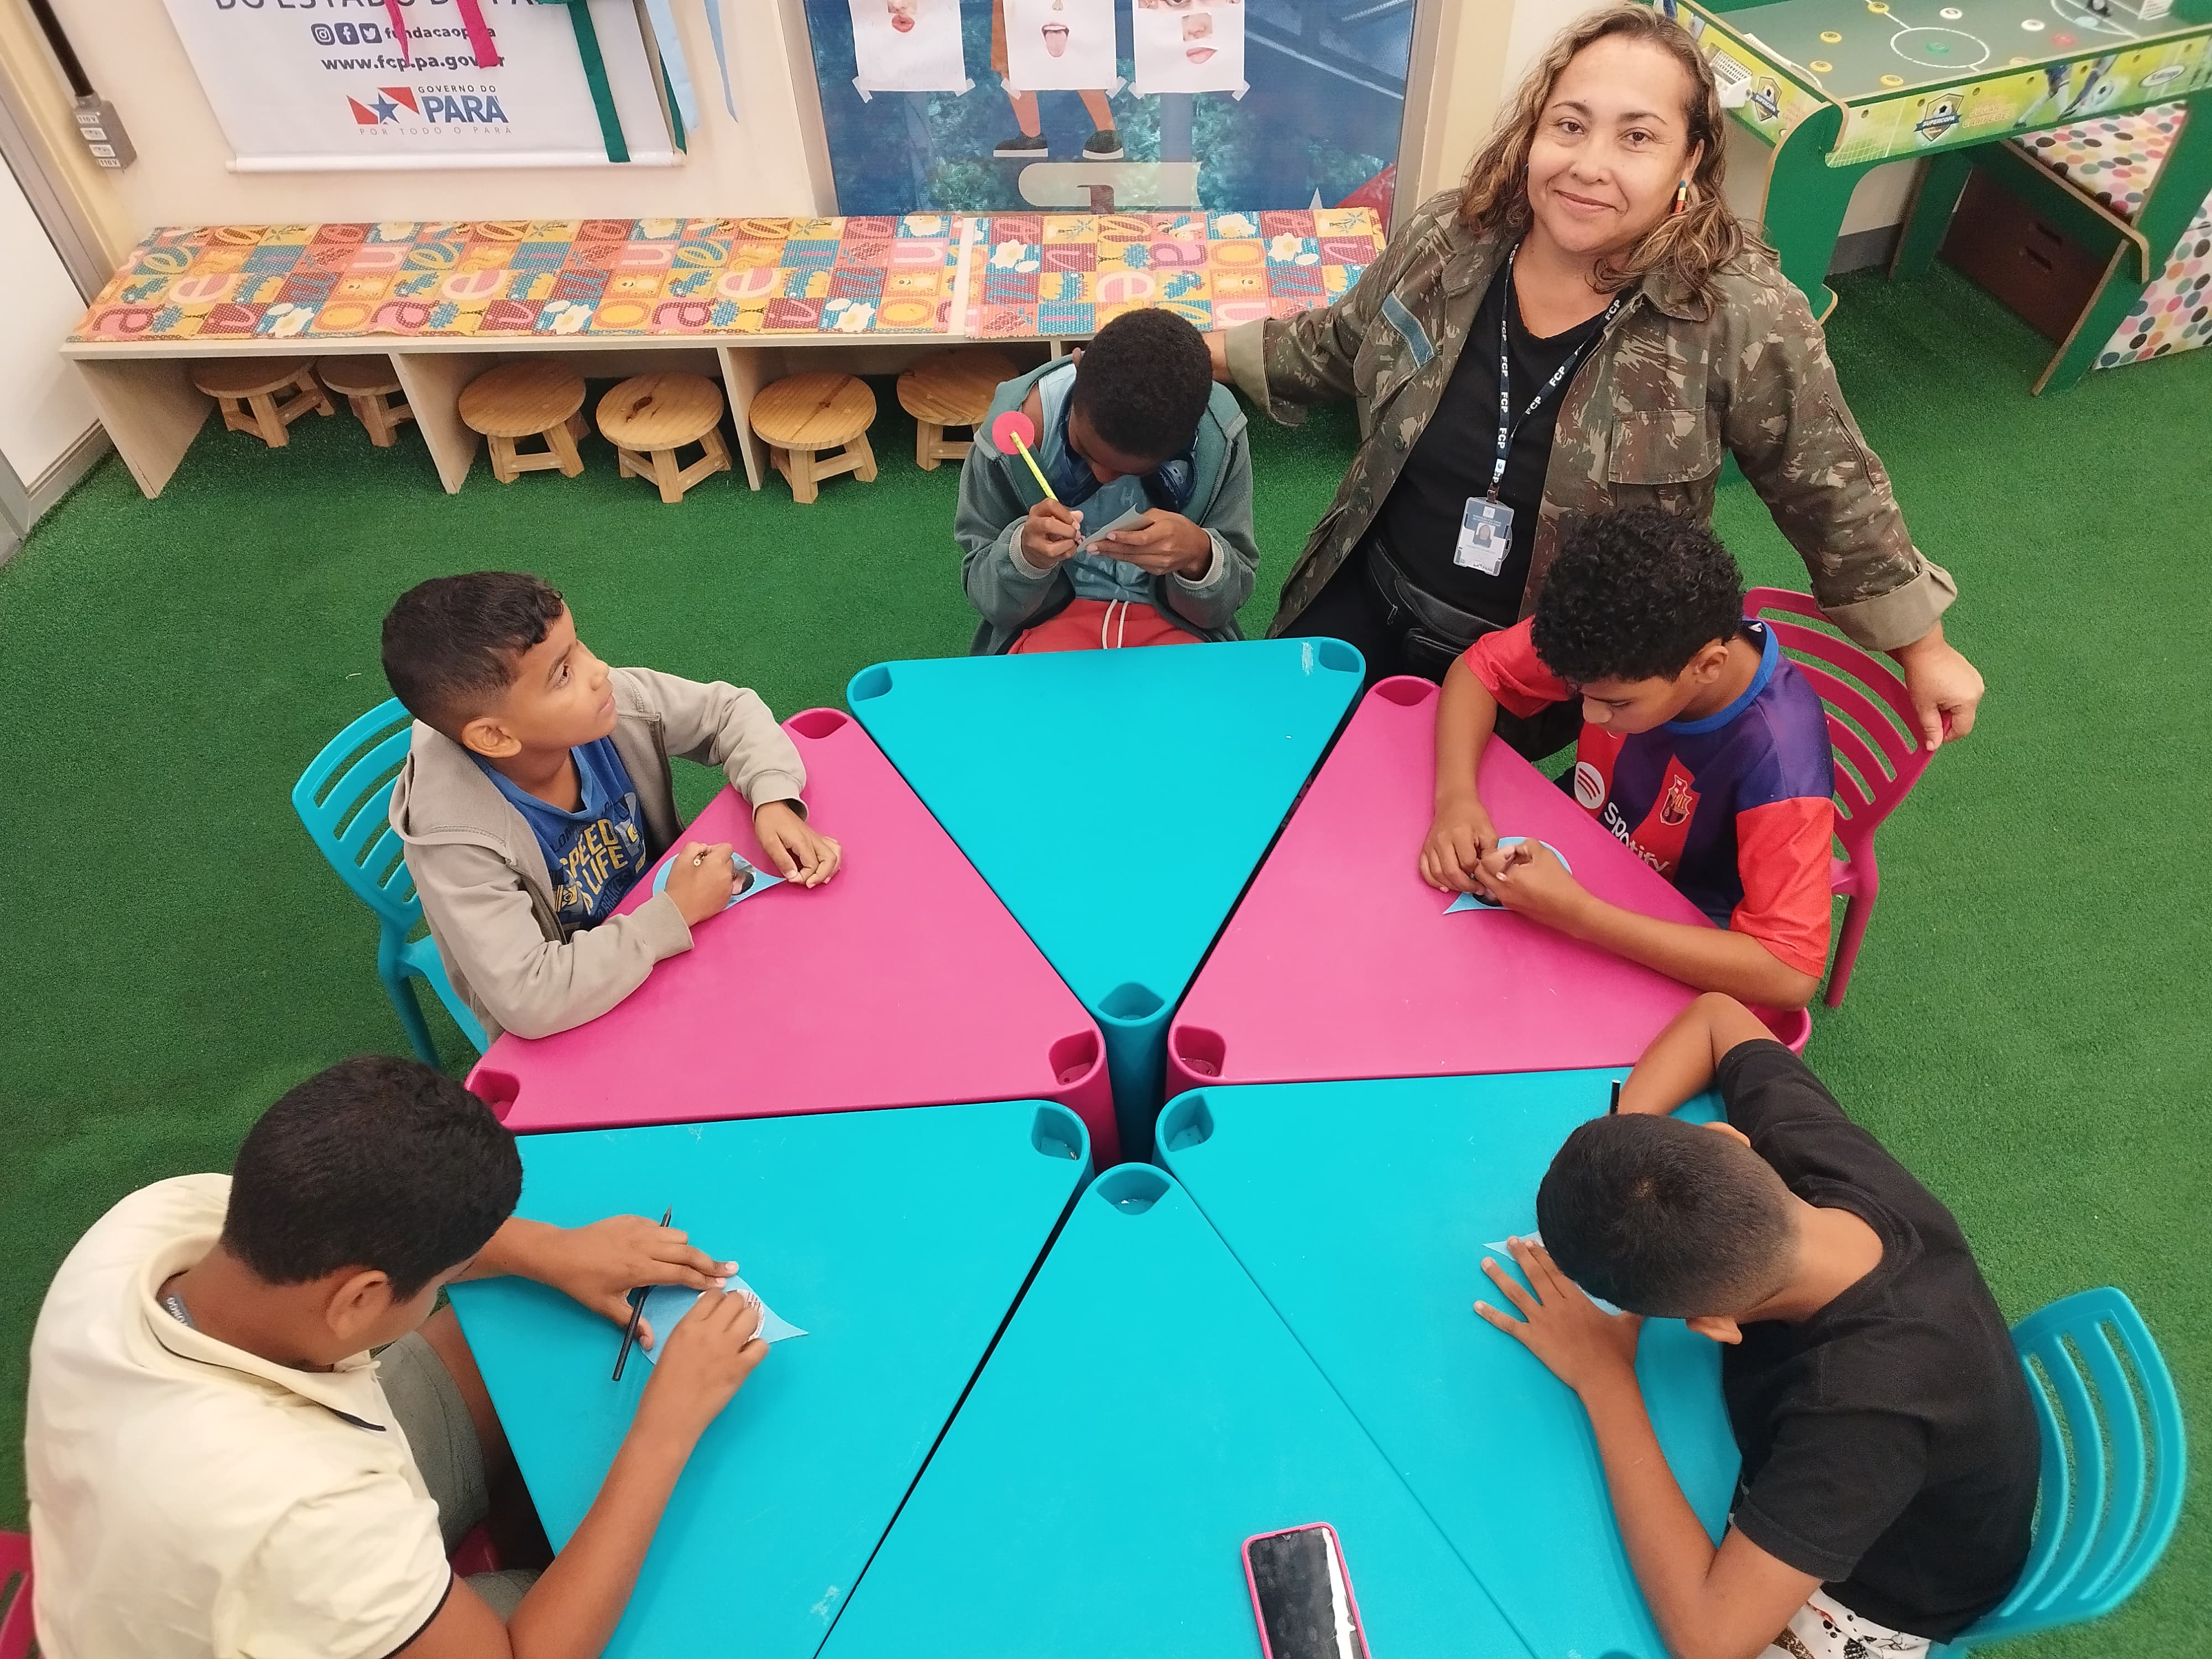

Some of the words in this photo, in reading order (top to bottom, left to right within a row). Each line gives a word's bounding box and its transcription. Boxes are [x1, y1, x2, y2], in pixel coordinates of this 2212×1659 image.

[385, 27, 497, 39] fndacaopa
[321, 55, 505, 71] www.fcp.pa.govr
[418, 85, 475, 93] GOVERNO
[481, 85, 497, 93] DO
[453, 126, 462, 134] O
[1922, 115, 1955, 127] SUPERCOPA
[1605, 299, 1621, 321] FCP
[1548, 366, 1566, 387] FCP
[1500, 392, 1509, 414] FCP
[1525, 395, 1542, 415] FCP
[1497, 427, 1507, 449] FCP
[1604, 801, 1670, 872] Spotify
[582, 845, 629, 895] LIFE
